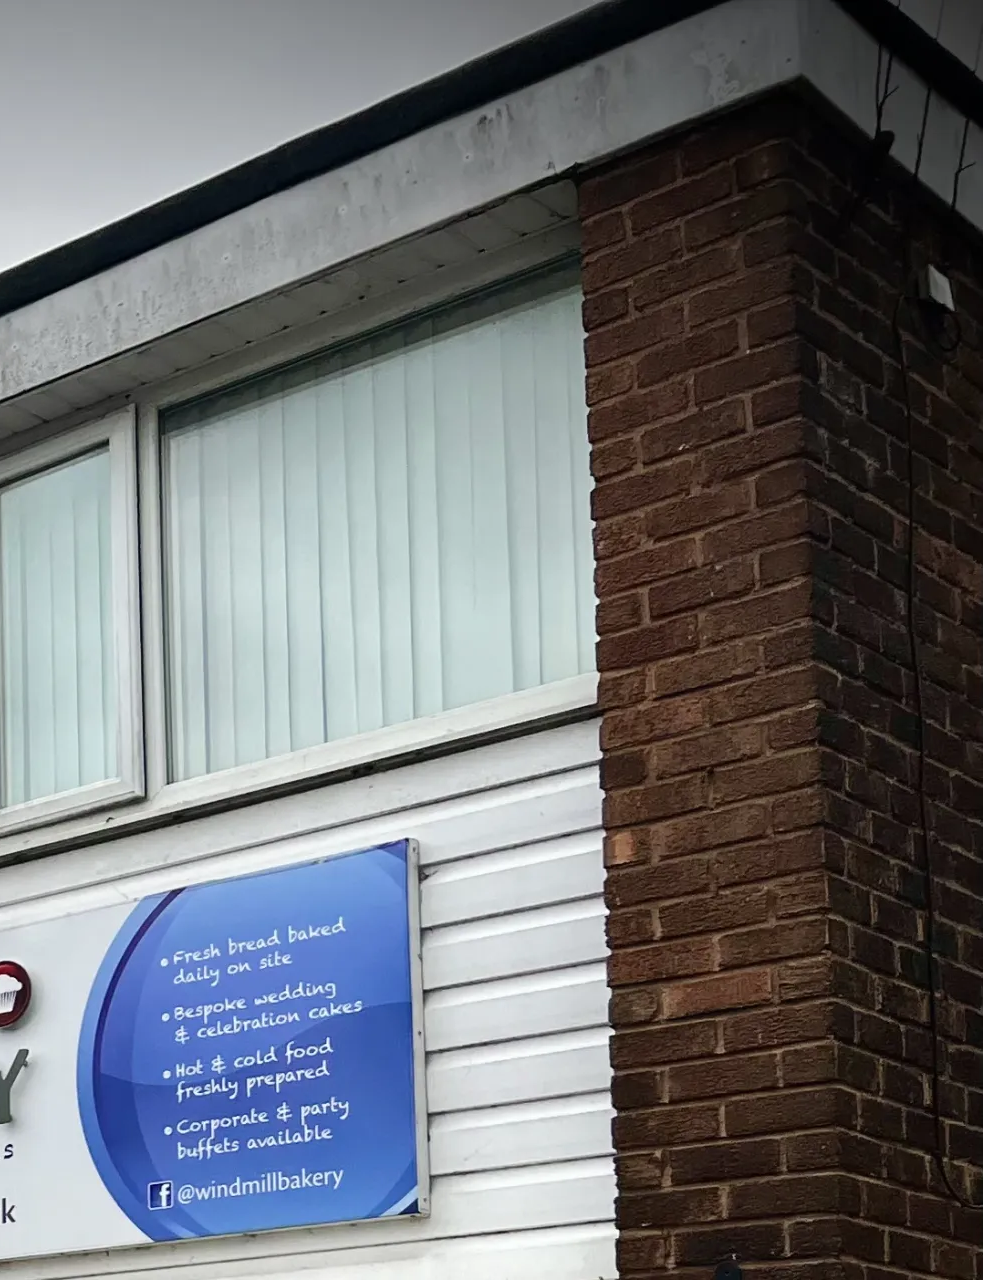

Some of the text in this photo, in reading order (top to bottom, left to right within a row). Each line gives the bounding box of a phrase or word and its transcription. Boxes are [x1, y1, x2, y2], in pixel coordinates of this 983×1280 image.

[172, 916, 346, 965] Fresh bread baked
[173, 951, 293, 987] daily on site
[174, 981, 336, 1024] Bespoke wedding
[174, 1000, 363, 1044] & celebration cakes
[175, 1037, 334, 1078] Hot & cold food
[175, 1060, 331, 1103] freshly prepared
[176, 1096, 350, 1139] Corporate & party
[177, 1124, 333, 1160] buffets available
[177, 1168, 344, 1205] @windmillbakery
